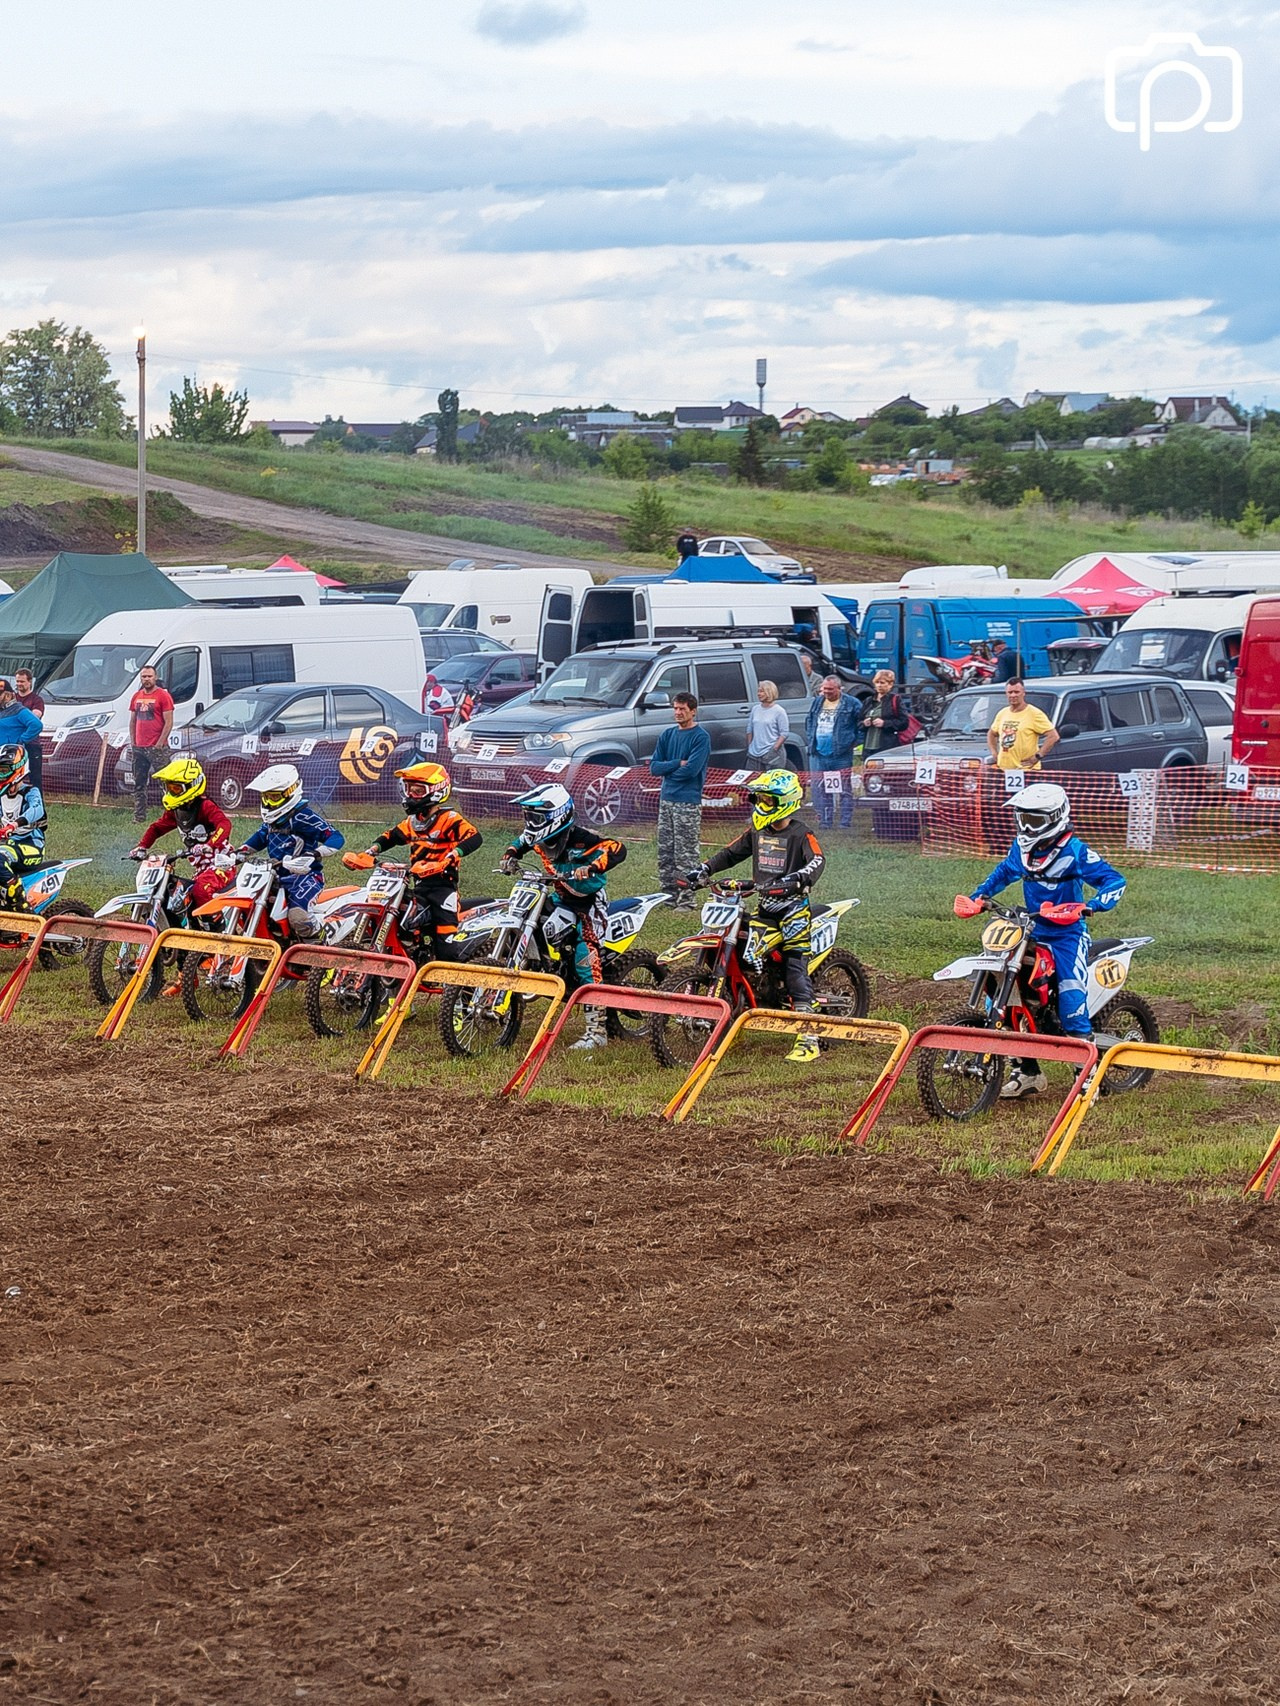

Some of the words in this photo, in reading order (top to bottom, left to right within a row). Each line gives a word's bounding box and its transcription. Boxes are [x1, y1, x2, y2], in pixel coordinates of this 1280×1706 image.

[170, 736, 179, 746] 10
[245, 740, 254, 750] 11
[302, 743, 312, 751] 12
[422, 738, 434, 748] 14
[481, 748, 493, 758] 15
[550, 762, 562, 771] 16
[734, 773, 746, 782] 19
[919, 768, 933, 780] 21
[1228, 772, 1246, 785] 24
[826, 777, 840, 789] 20
[1007, 776, 1022, 788] 22
[1122, 779, 1139, 791] 23
[40, 873, 61, 894] 491
[368, 879, 399, 892] 227
[703, 905, 737, 924] 777
[610, 914, 634, 940] 20
[985, 922, 1018, 946] 117
[1099, 962, 1123, 984] 117
